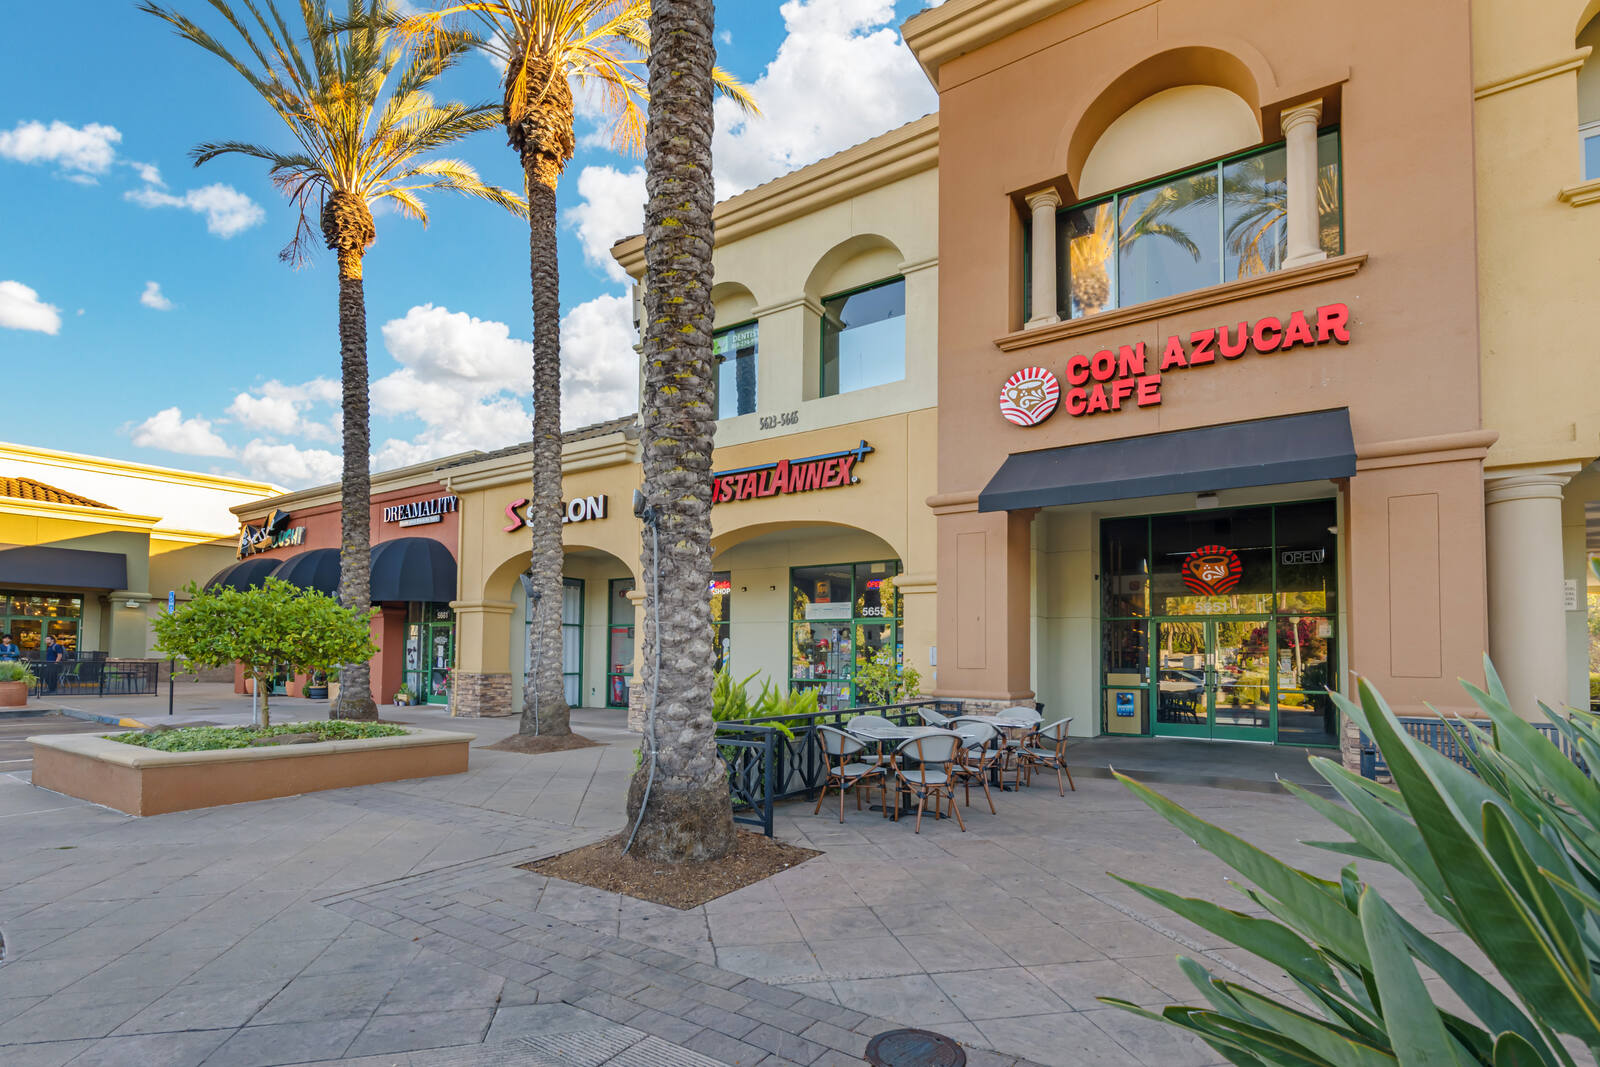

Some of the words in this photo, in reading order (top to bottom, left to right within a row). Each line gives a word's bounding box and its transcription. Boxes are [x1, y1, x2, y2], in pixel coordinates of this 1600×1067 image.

[1065, 341, 1147, 387] CON
[1160, 303, 1350, 372] AZUCAR
[1065, 374, 1161, 416] CAFE
[384, 496, 458, 523] DREAMALITY
[1284, 551, 1322, 563] OPEN
[862, 607, 887, 616] 5655
[1195, 601, 1228, 613] 5651
